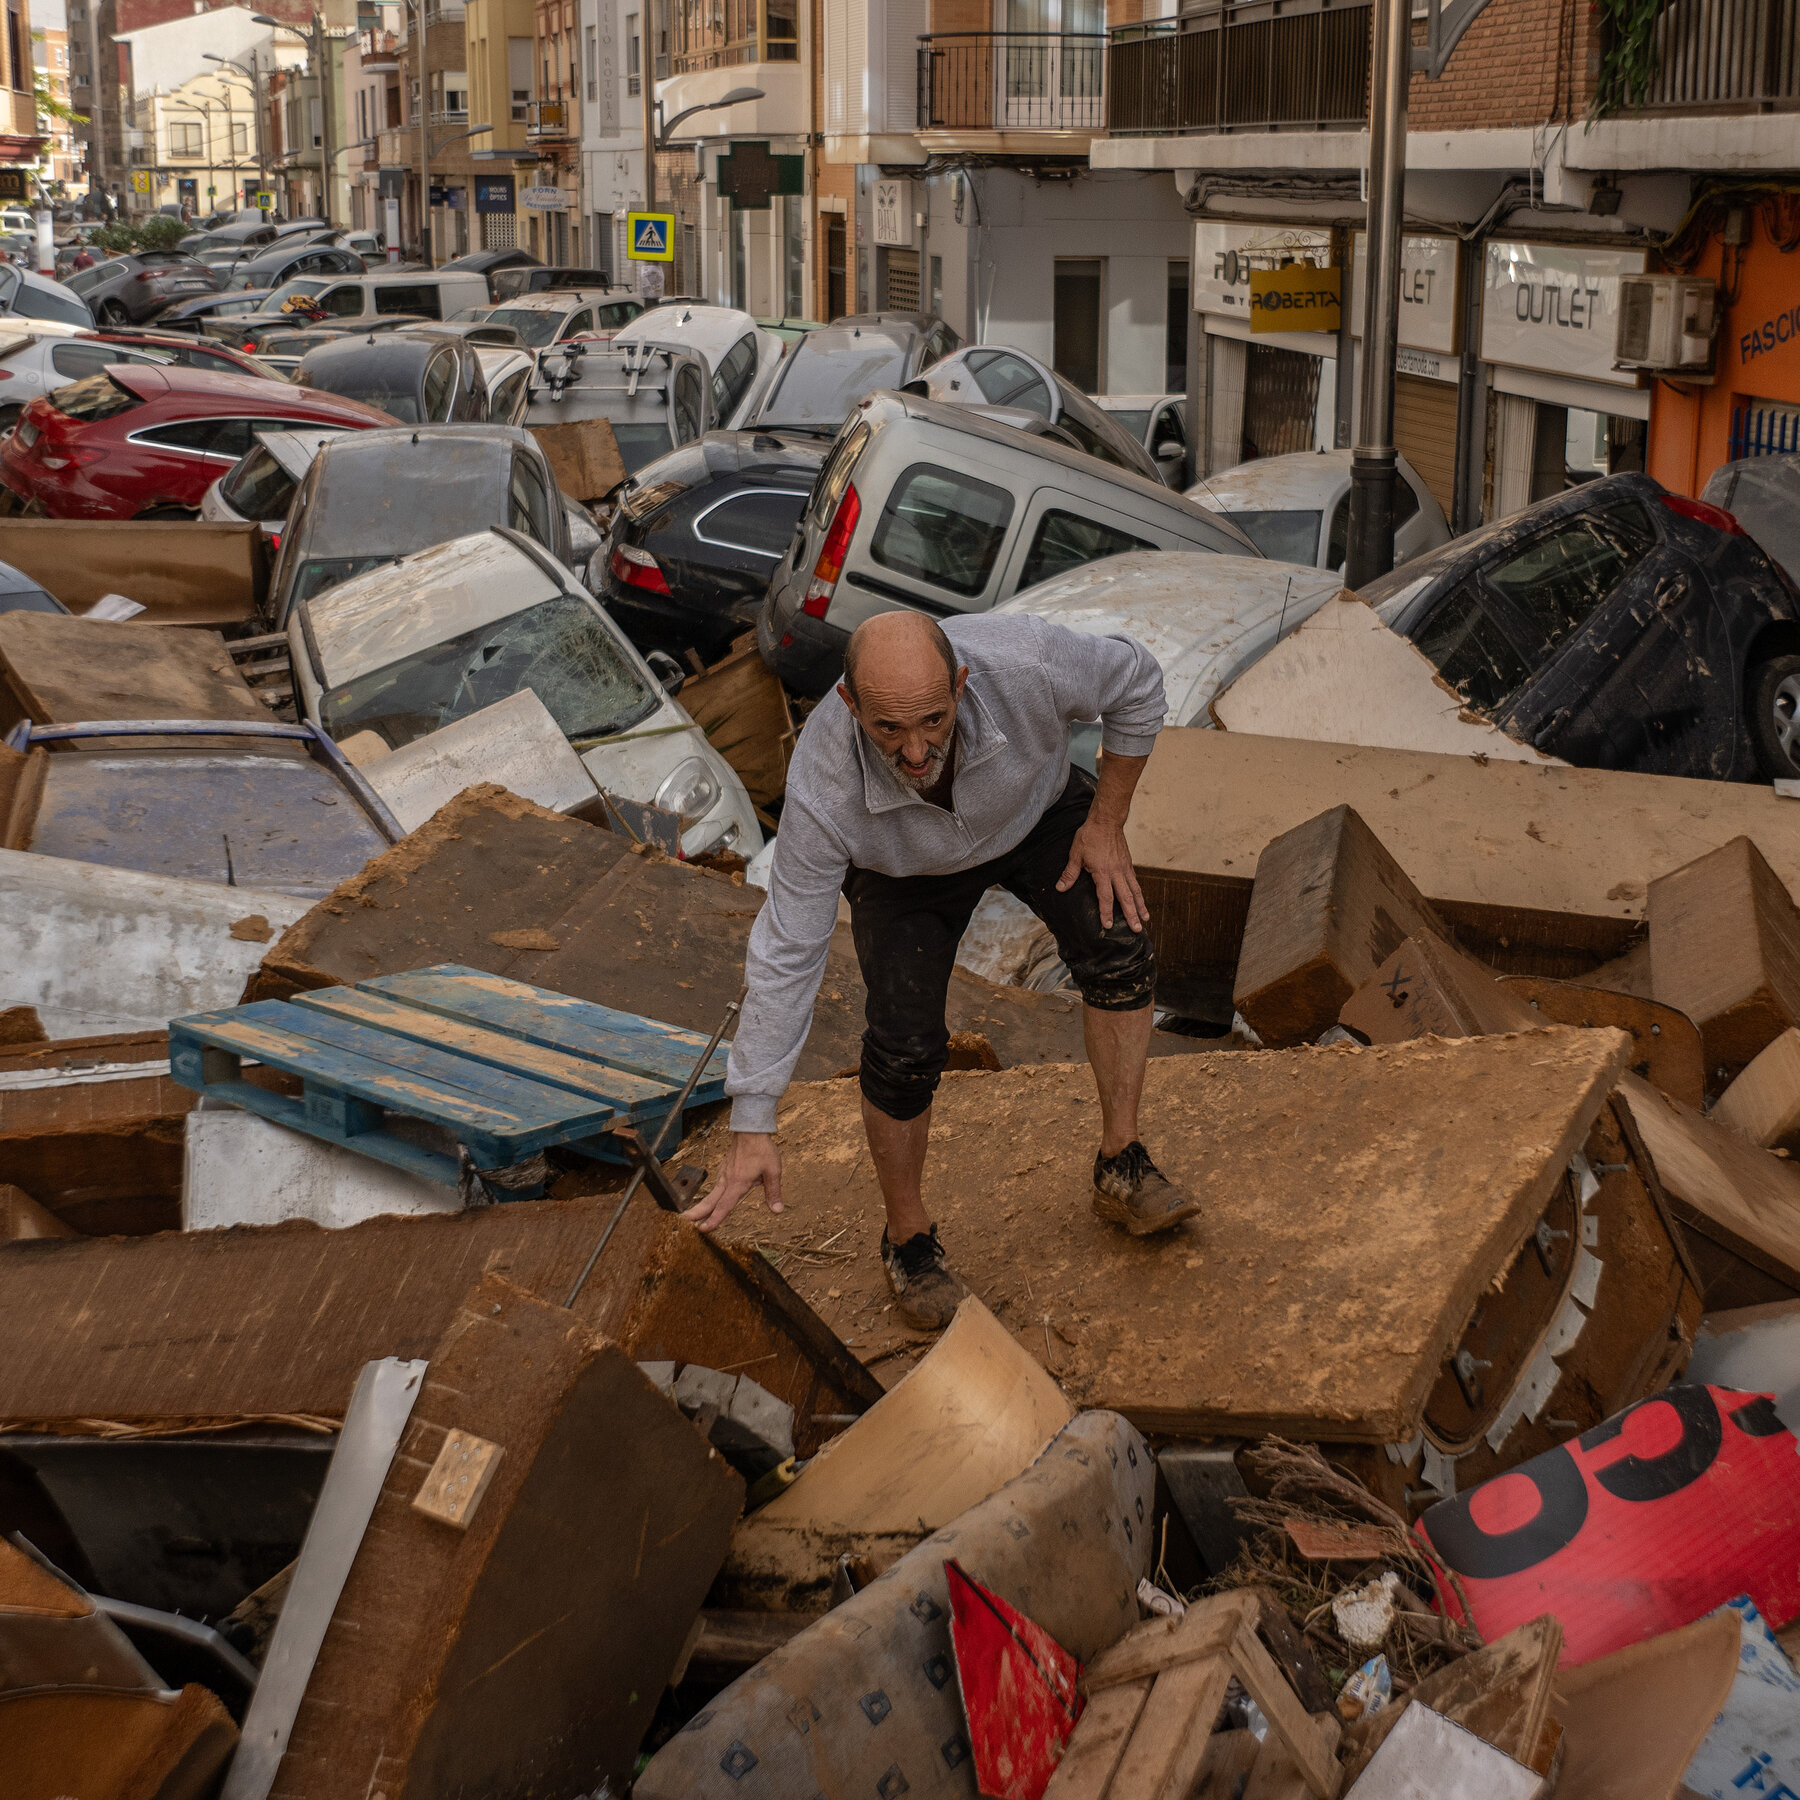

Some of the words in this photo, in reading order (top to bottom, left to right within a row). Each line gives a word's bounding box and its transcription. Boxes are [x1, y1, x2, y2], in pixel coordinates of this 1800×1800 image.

[532, 187, 558, 195] FORN
[1250, 290, 1341, 312] ROBERTA
[1515, 283, 1599, 330] OUTLET
